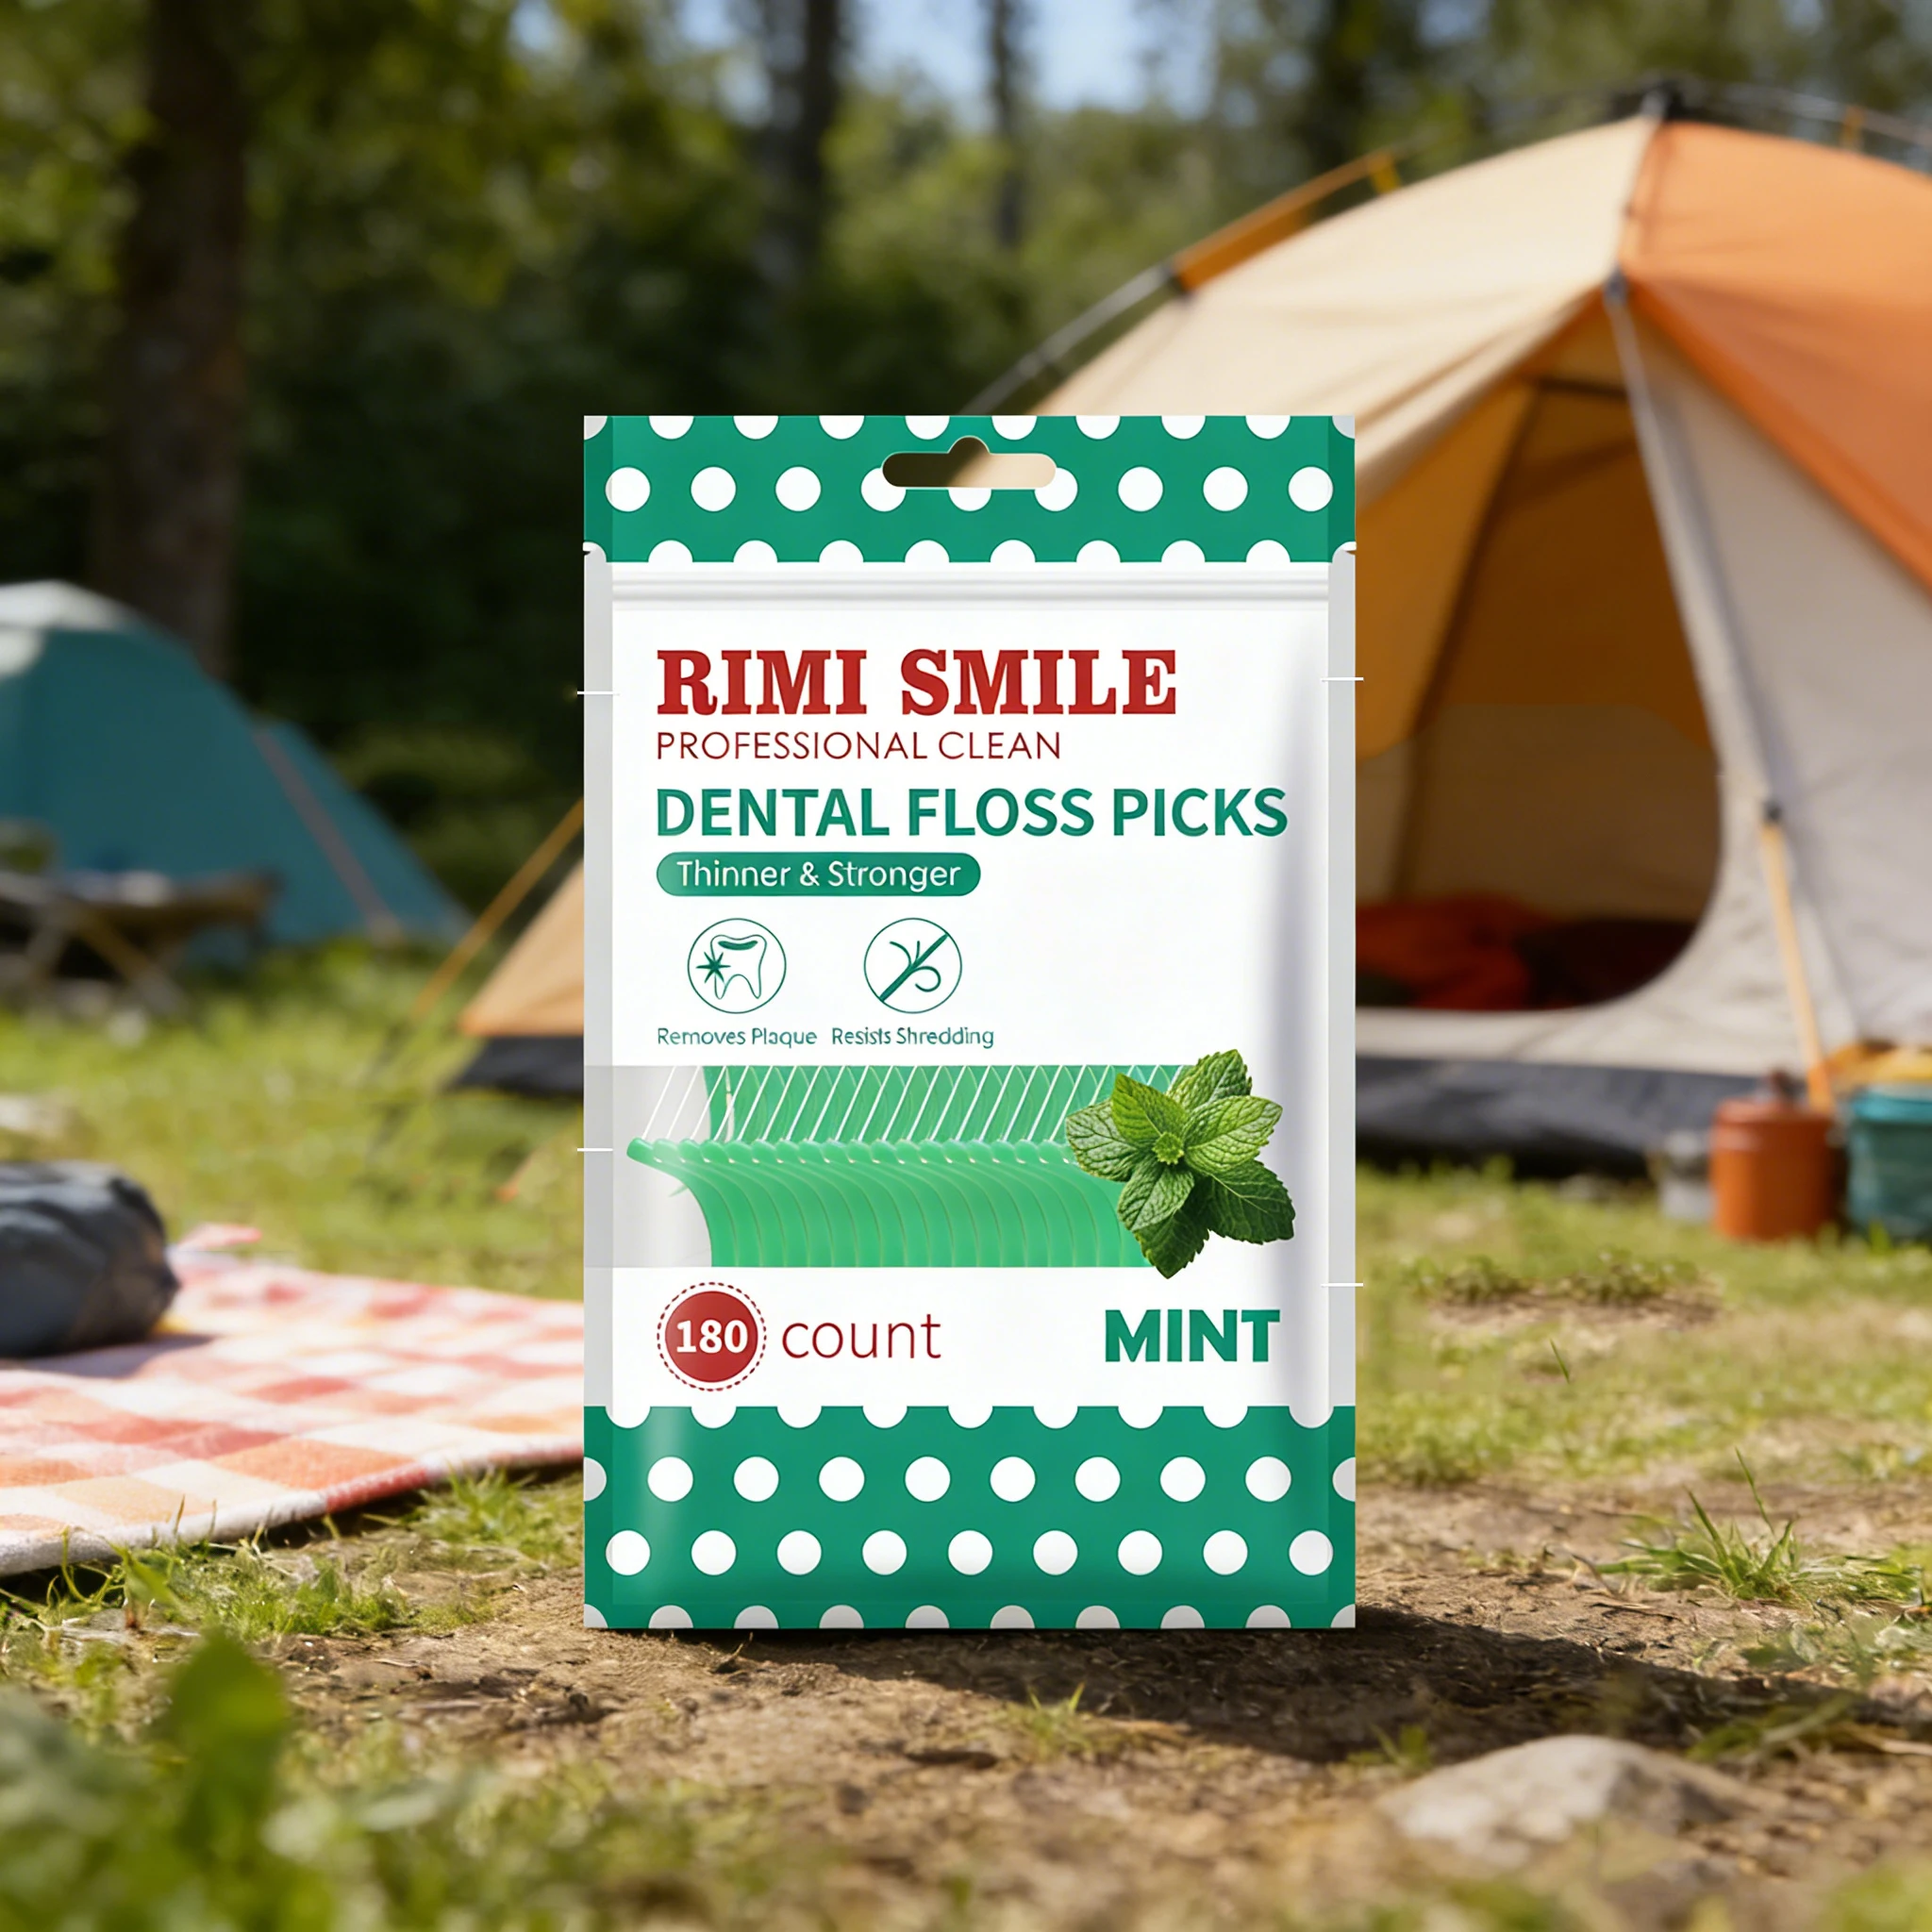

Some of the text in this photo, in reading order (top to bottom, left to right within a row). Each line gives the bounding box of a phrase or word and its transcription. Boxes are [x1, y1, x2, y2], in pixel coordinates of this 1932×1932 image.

[658, 649, 1175, 716] RIMI SMILE
[658, 731, 1059, 759] PROFESSIONAL CLEAN
[658, 788, 1289, 837] DENTAL FLOSS PICKS
[676, 859, 961, 892] Thinner & Stronger
[658, 1027, 818, 1049] Removes Plaque
[831, 1026, 994, 1050] Resists Shredding
[676, 1314, 941, 1358] 180 count
[1106, 1309, 1280, 1362] MINT
